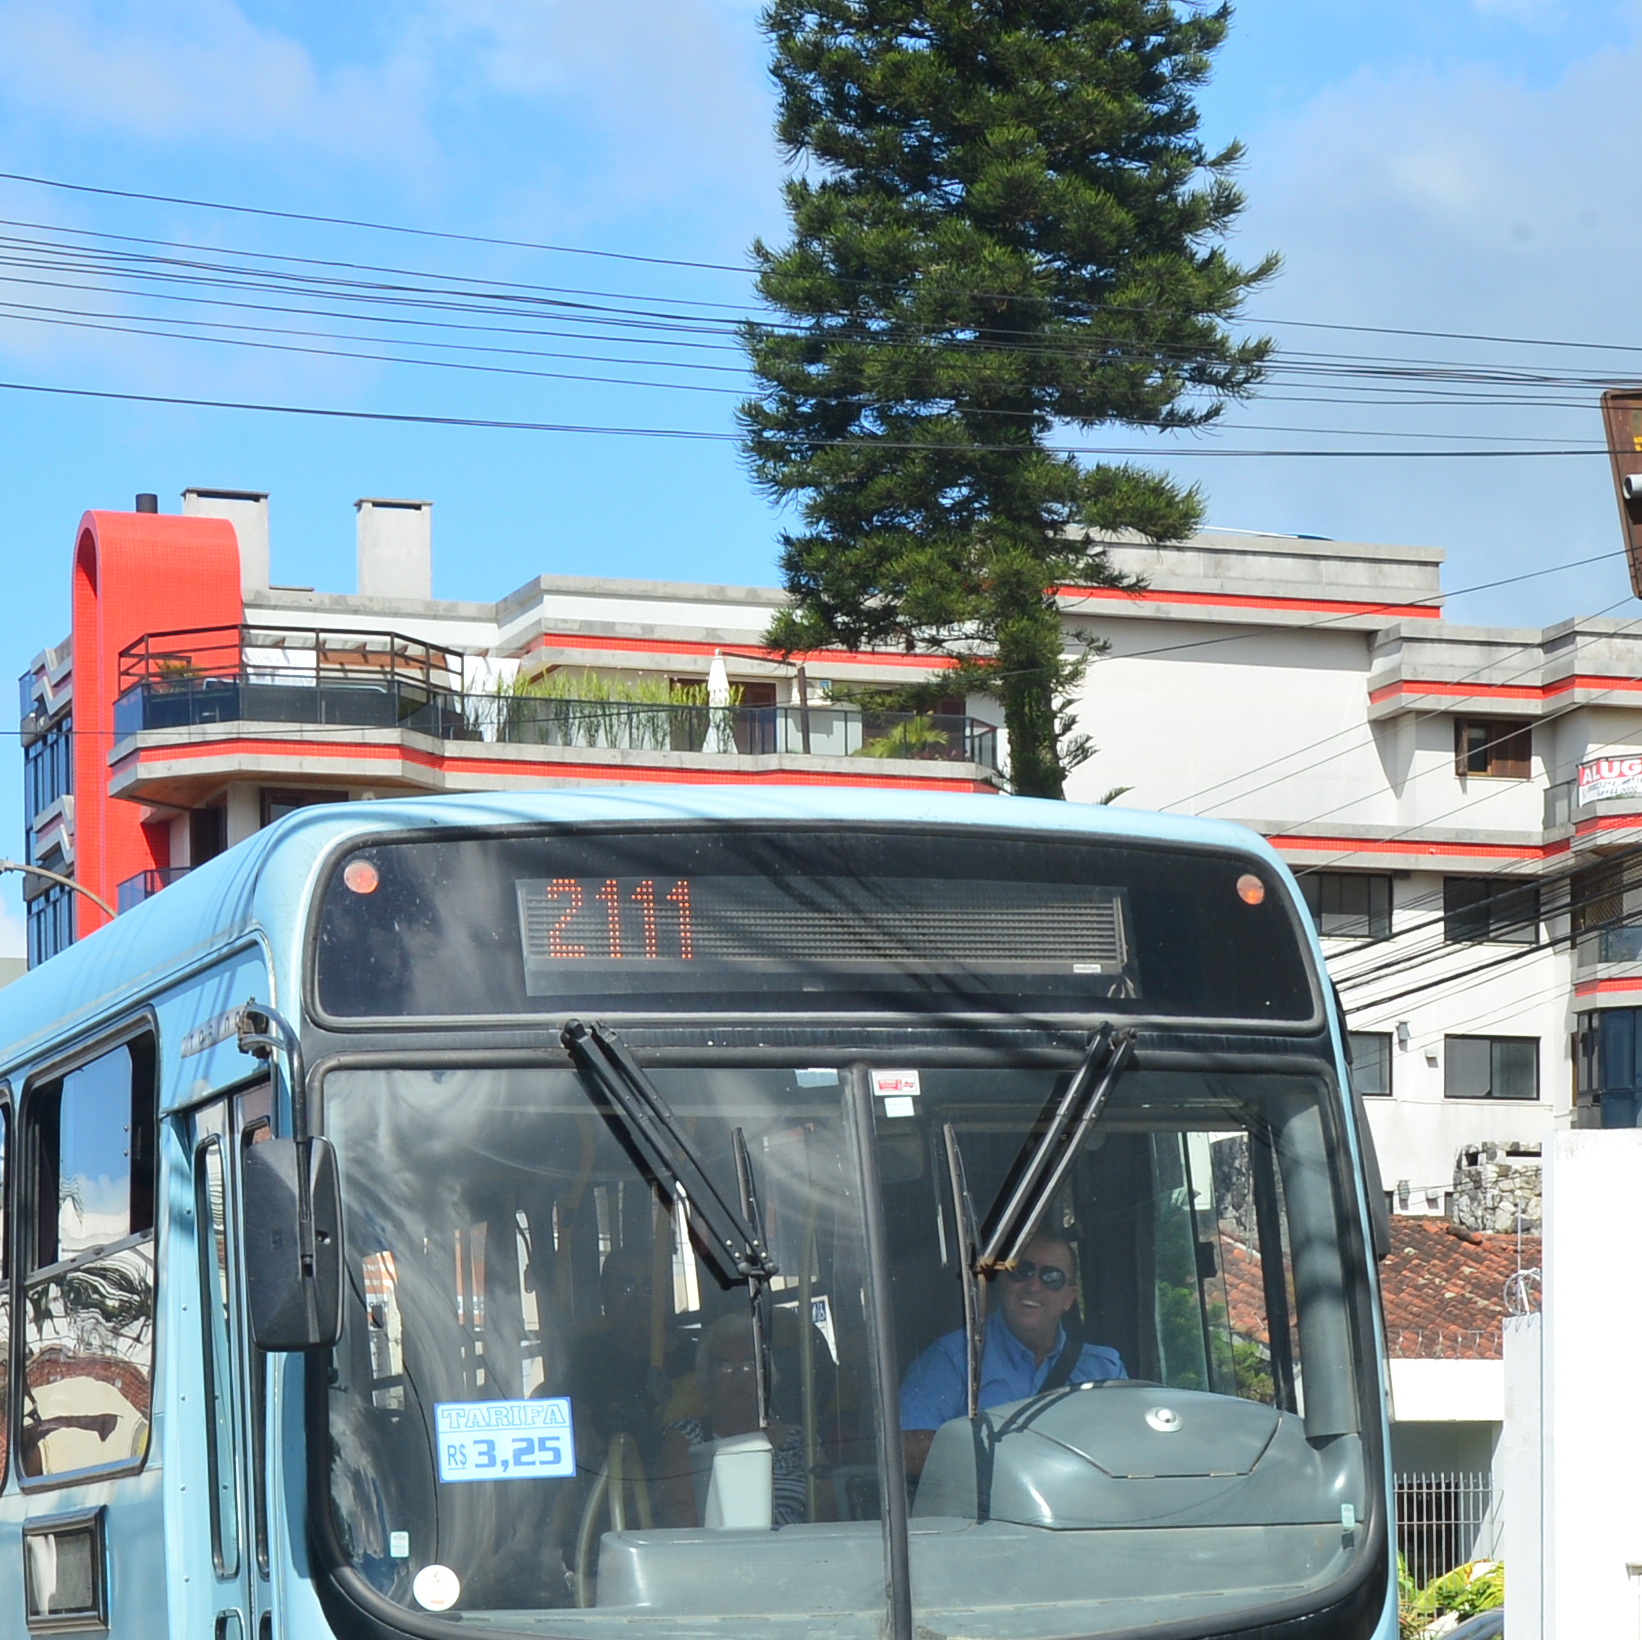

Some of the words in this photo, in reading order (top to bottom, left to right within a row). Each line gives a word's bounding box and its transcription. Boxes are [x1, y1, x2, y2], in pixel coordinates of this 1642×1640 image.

[546, 878, 692, 958] 2111
[442, 1404, 566, 1429] TARIFA
[446, 1443, 468, 1470] R$
[472, 1436, 562, 1473] 3,25
